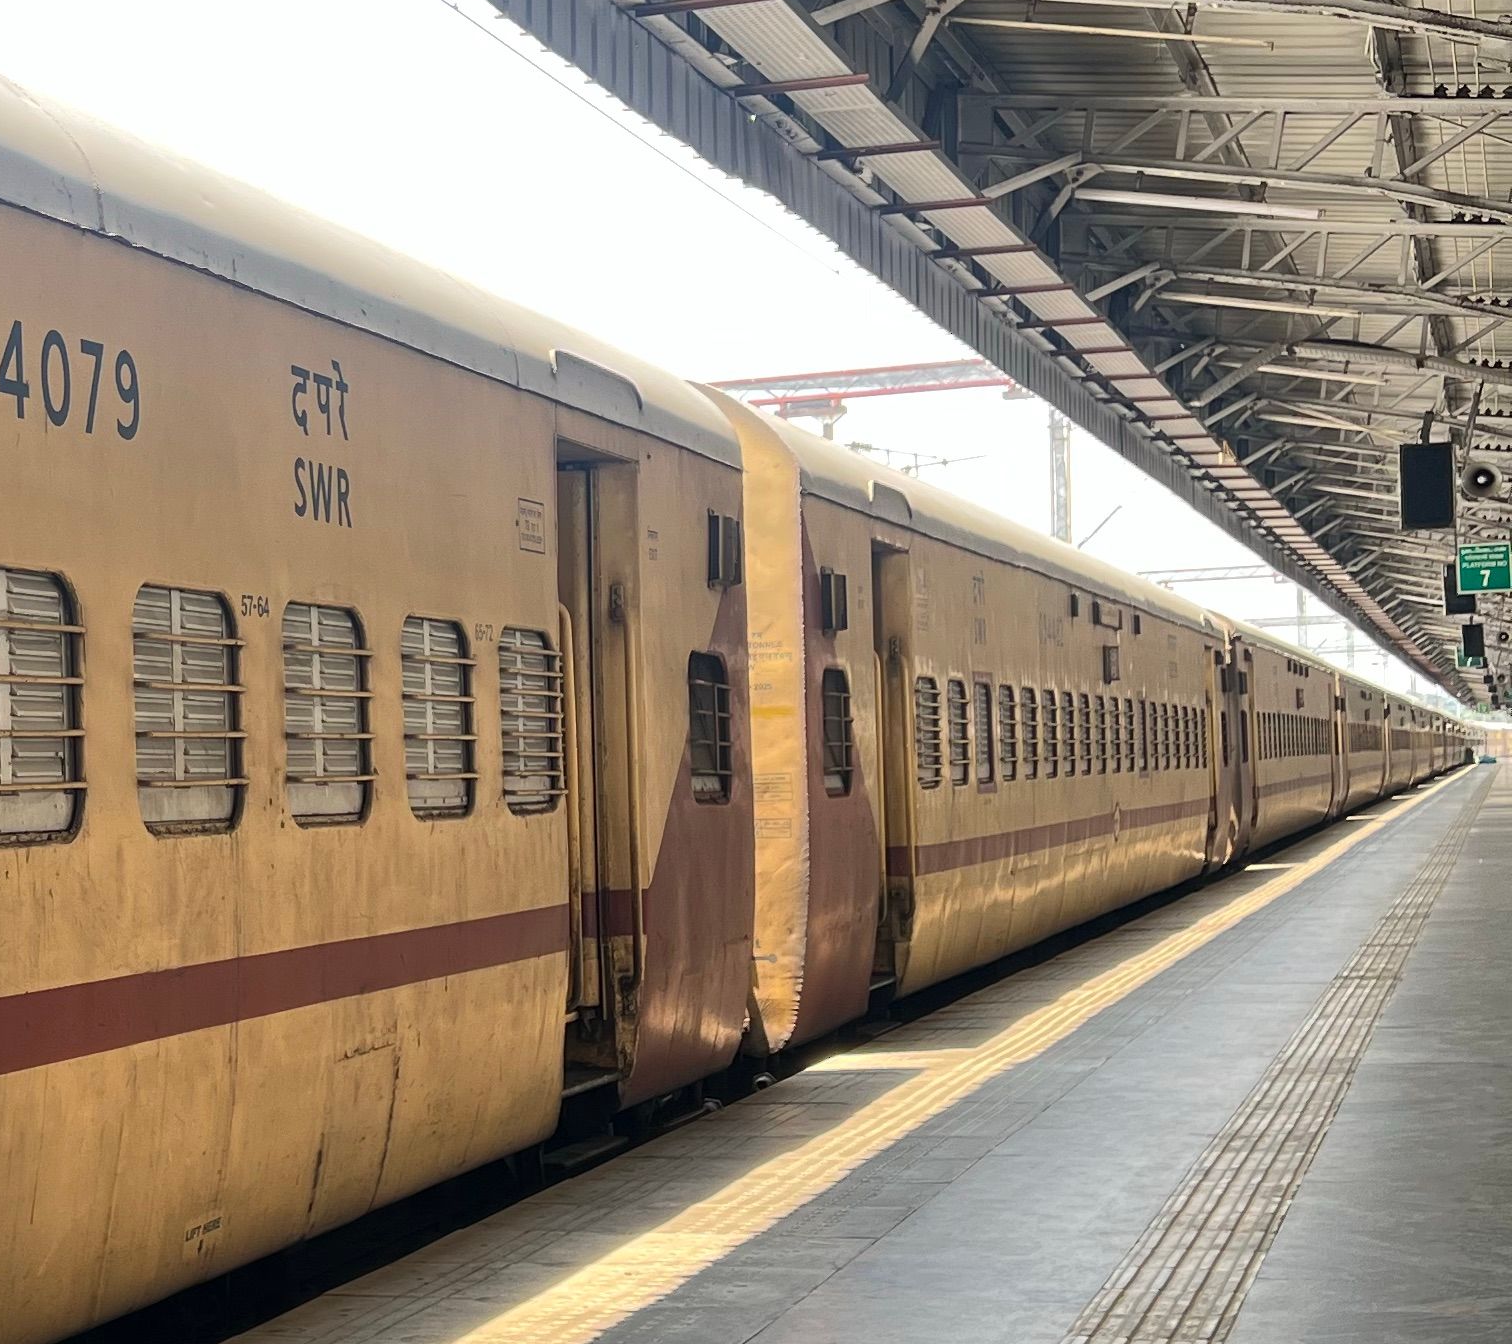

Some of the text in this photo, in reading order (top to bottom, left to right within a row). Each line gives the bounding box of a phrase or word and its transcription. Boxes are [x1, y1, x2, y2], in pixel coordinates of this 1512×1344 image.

[290, 359, 350, 441] दपरे
[294, 456, 353, 529] SWR
[1479, 569, 1491, 588] 7
[240, 594, 270, 618] 57-64
